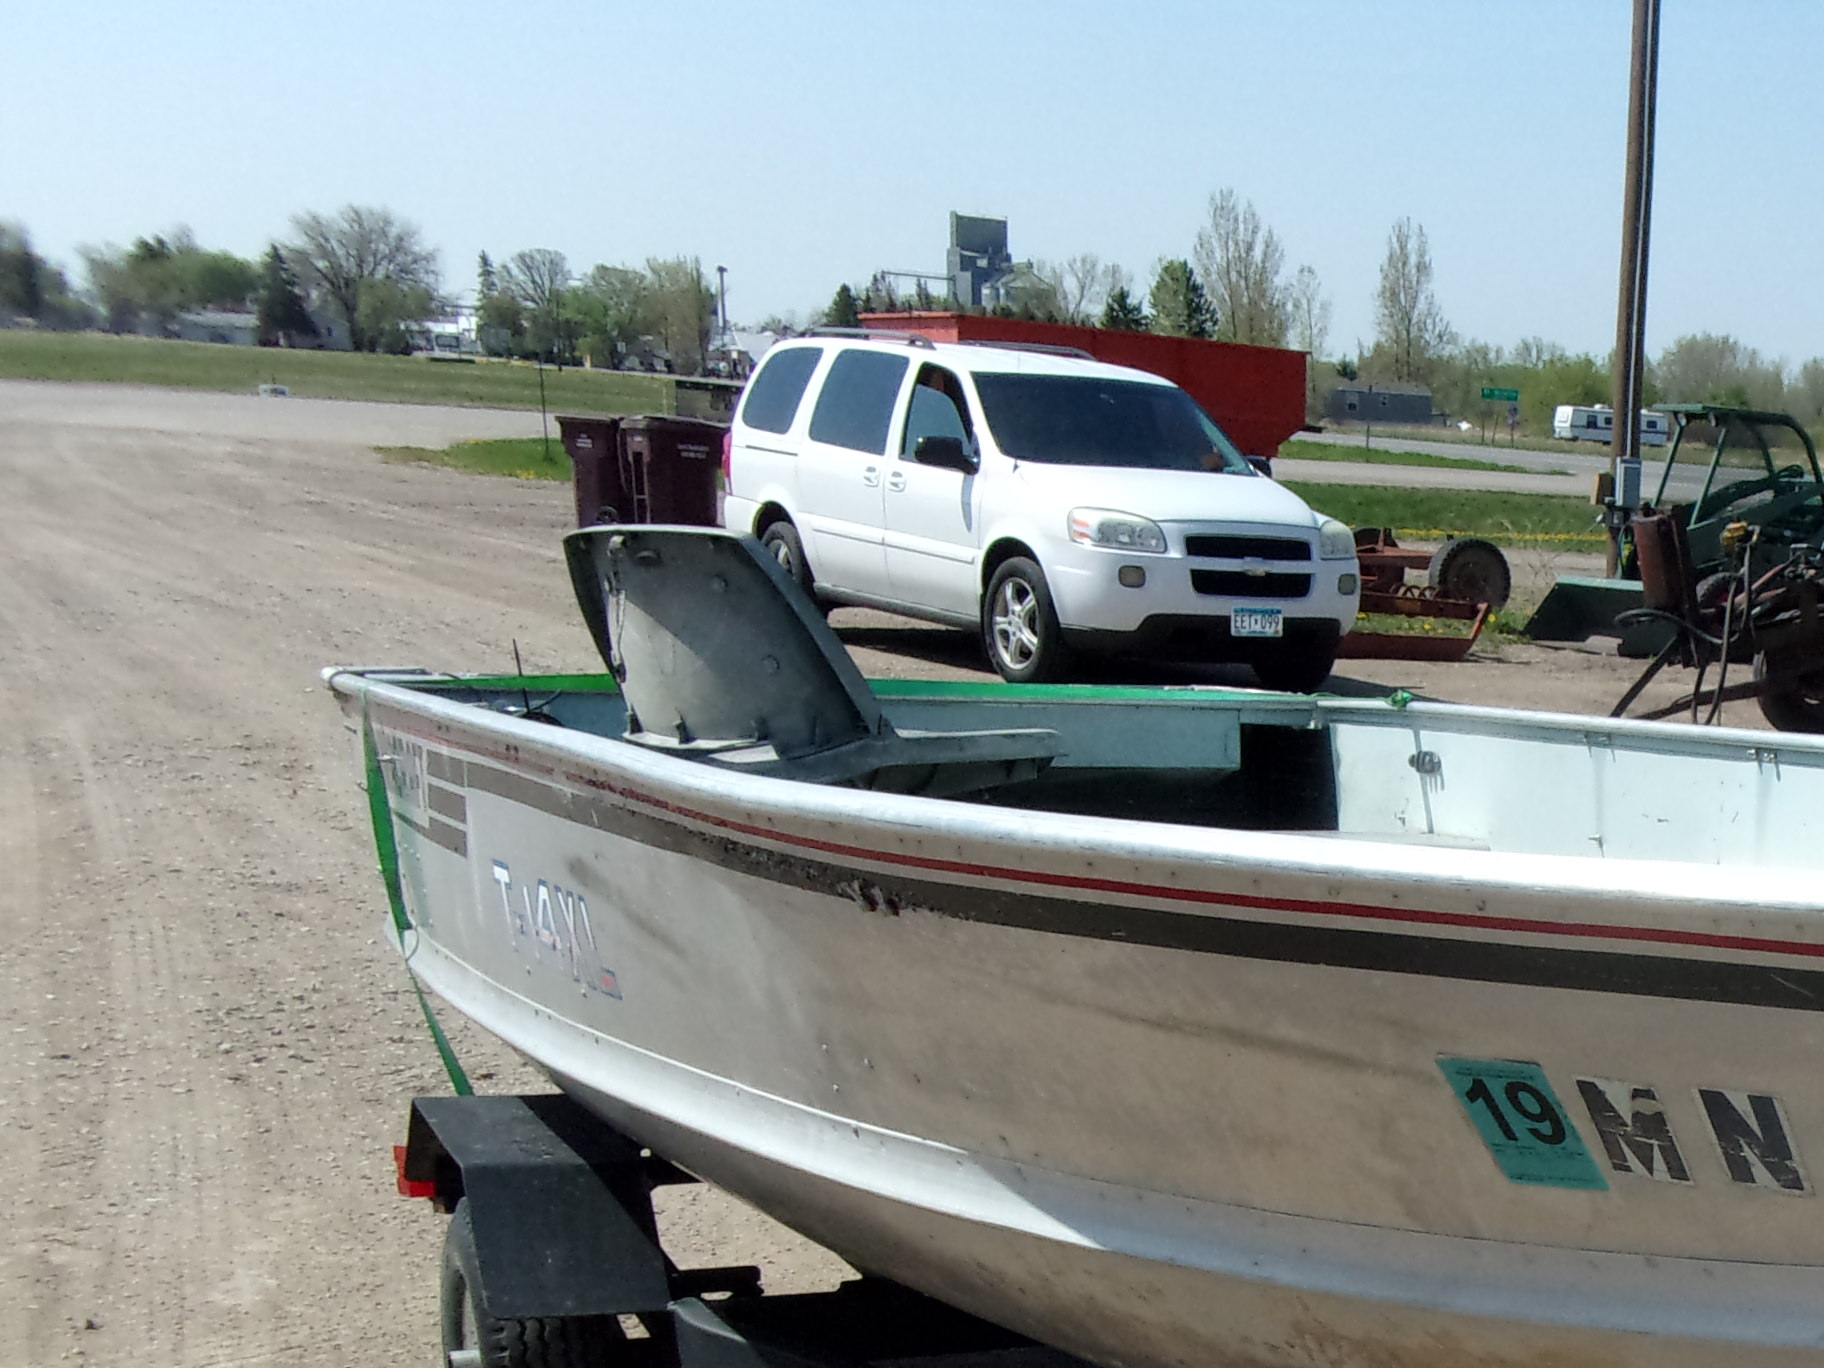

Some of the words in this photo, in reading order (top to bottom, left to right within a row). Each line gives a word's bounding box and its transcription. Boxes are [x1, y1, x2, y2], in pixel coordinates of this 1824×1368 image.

[1234, 614, 1253, 630] EET
[1260, 614, 1280, 630] 099
[1465, 1078, 1567, 1146] 19
